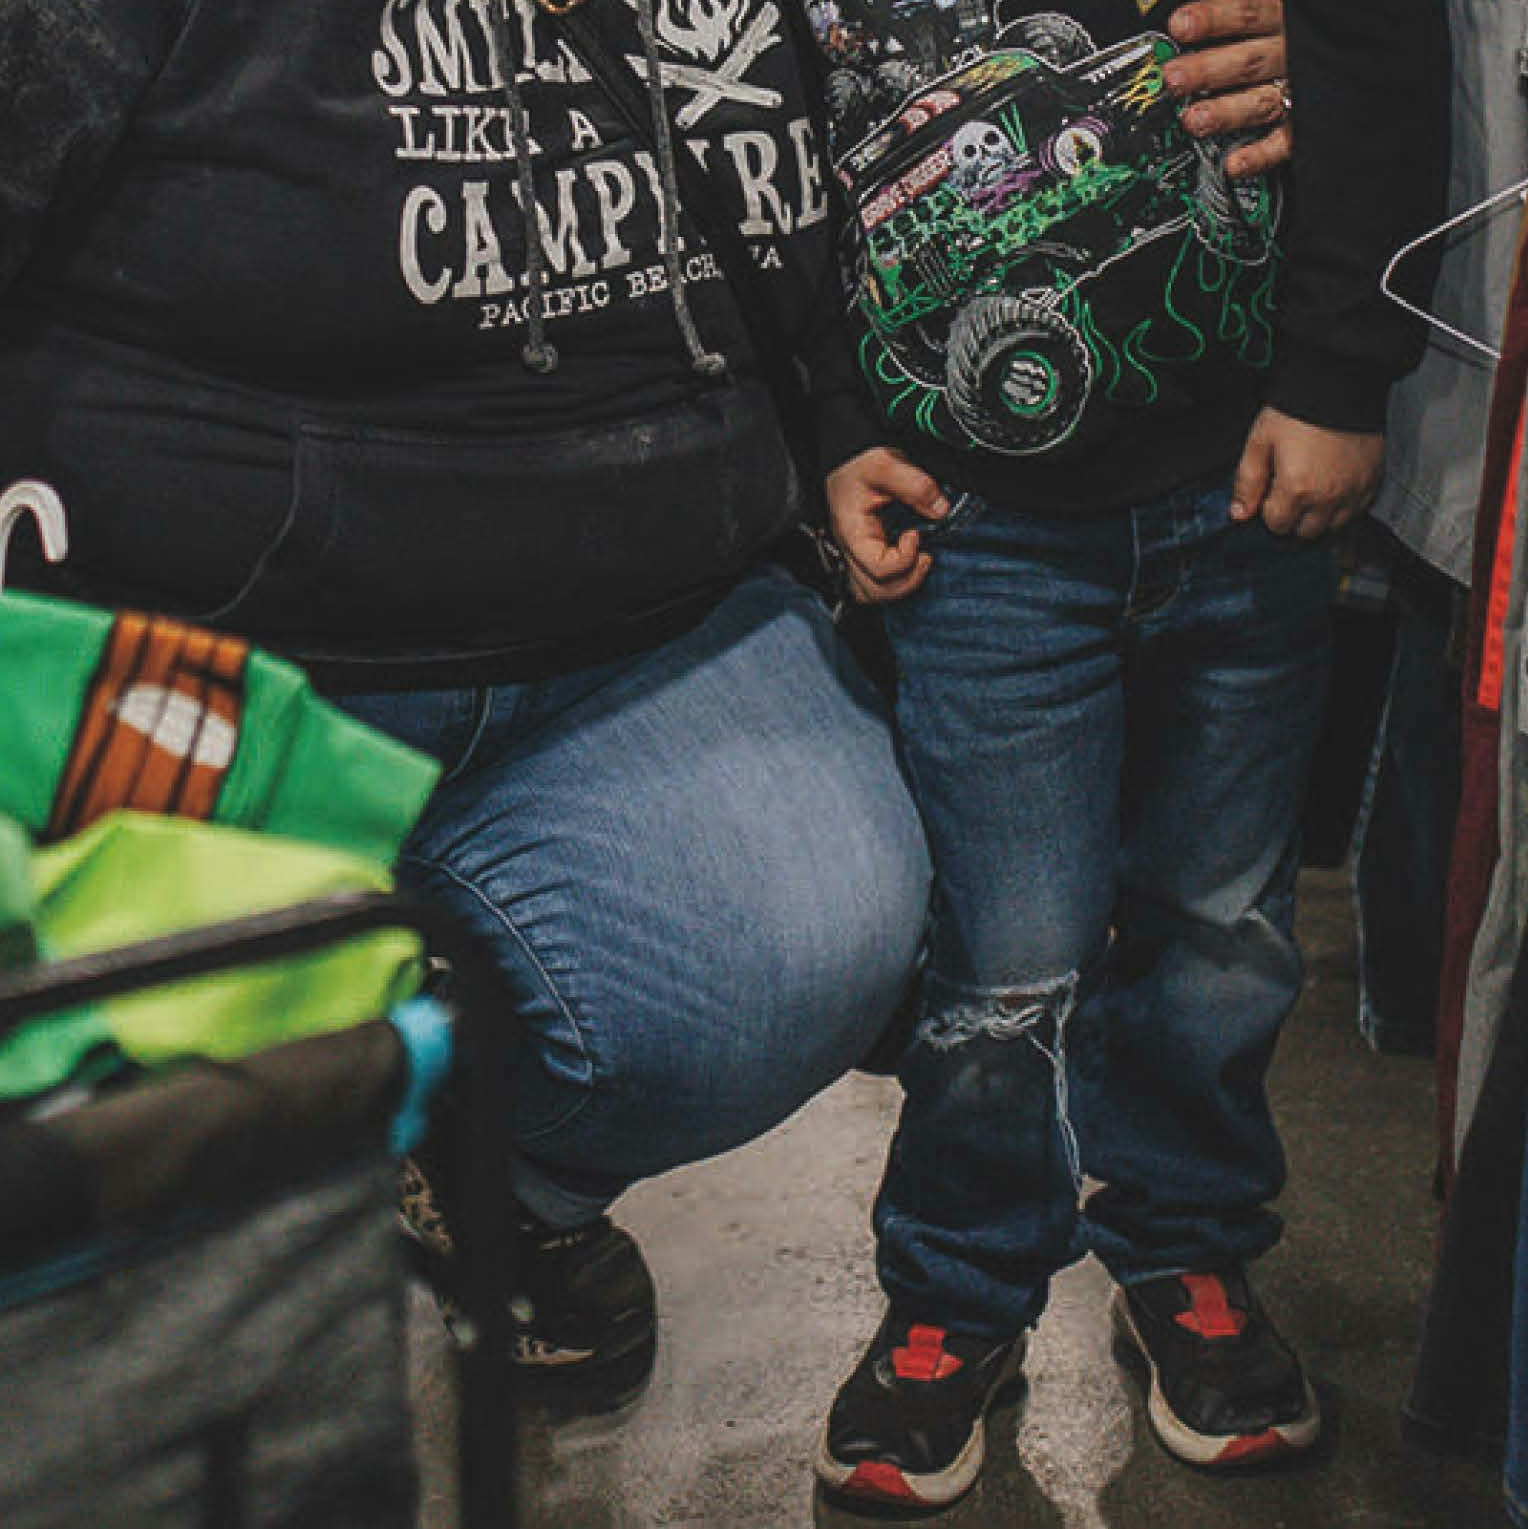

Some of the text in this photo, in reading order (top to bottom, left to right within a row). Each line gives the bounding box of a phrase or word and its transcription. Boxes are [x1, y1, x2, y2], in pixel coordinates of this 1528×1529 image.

[570, 110, 603, 152] A
[399, 117, 829, 305] CAMPRE
[625, 253, 724, 298] BECH
